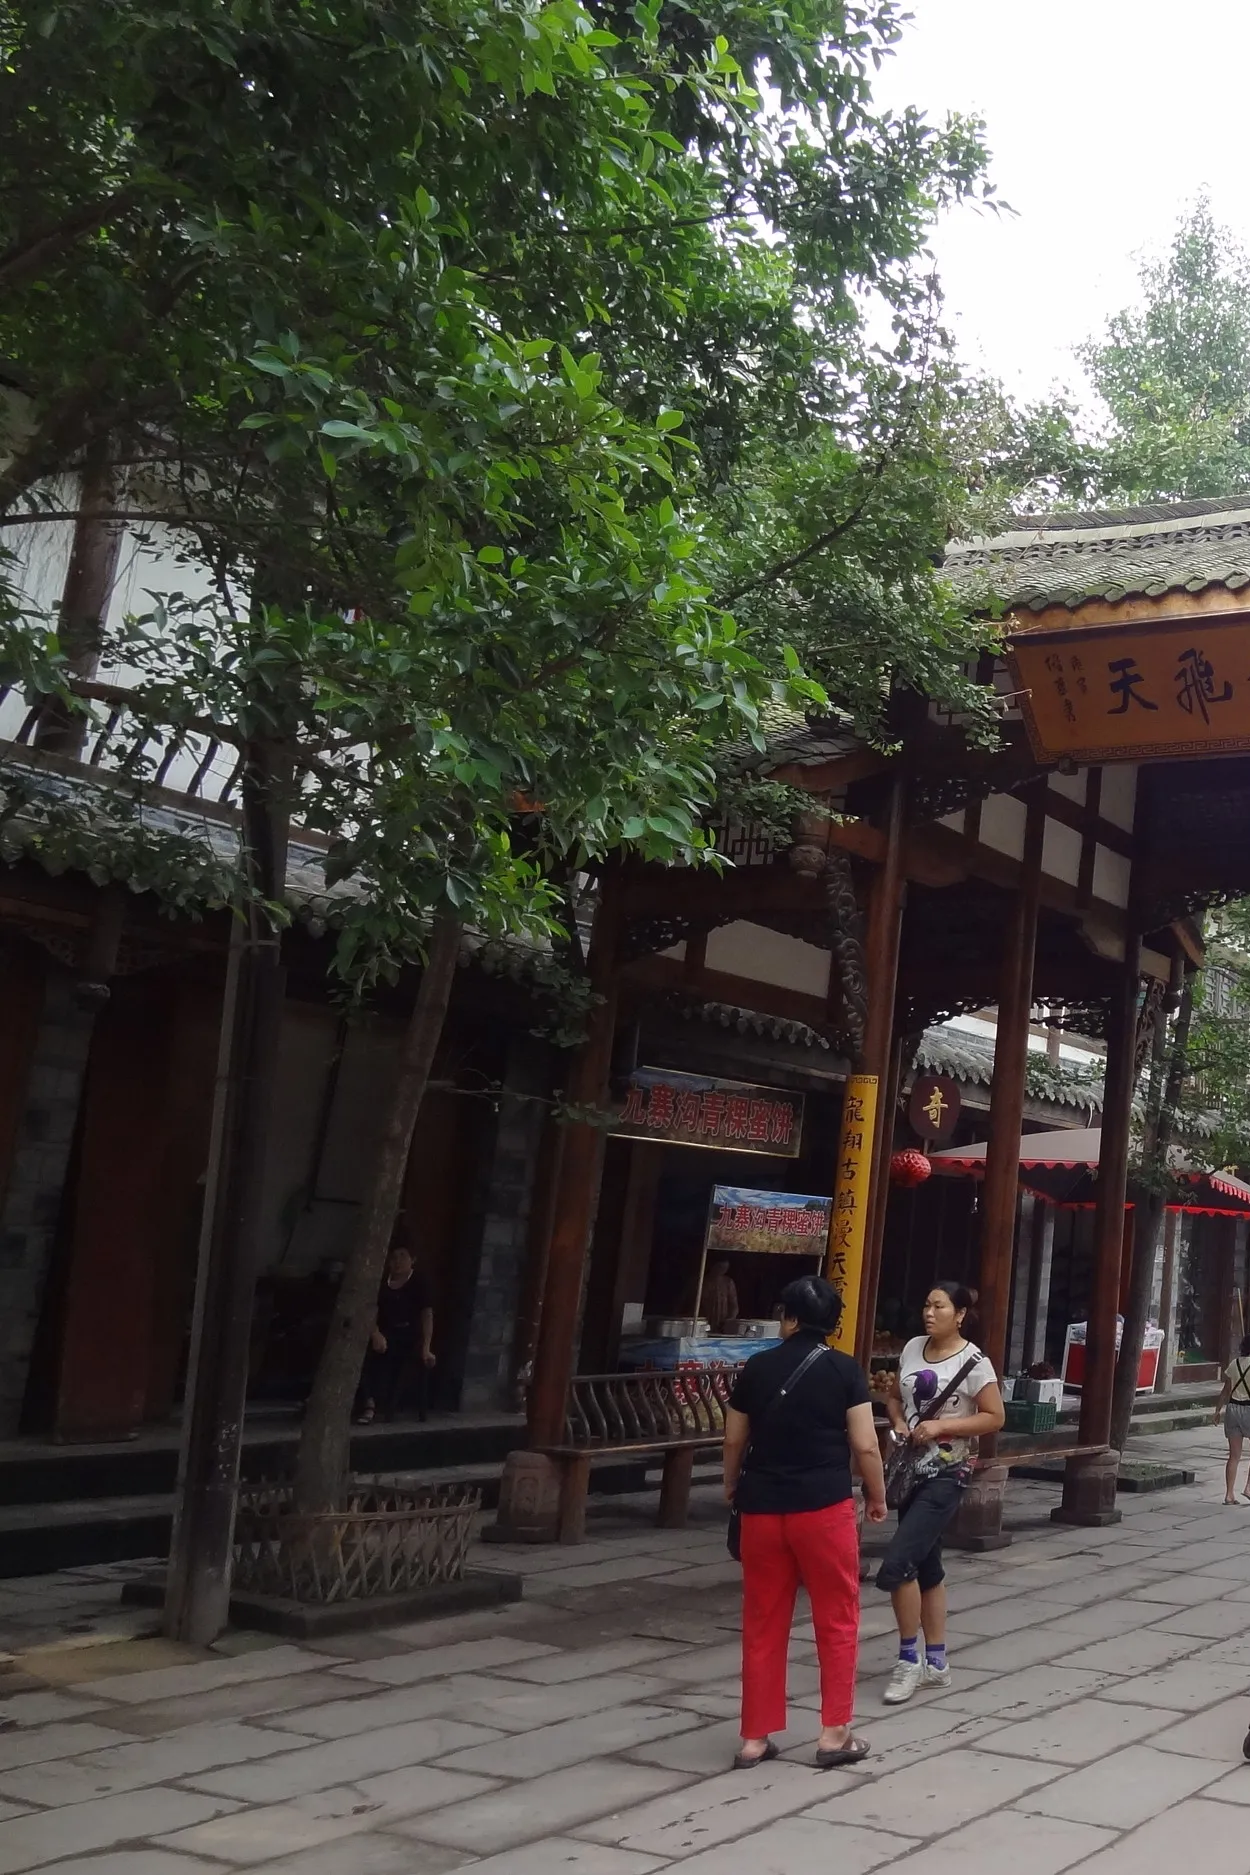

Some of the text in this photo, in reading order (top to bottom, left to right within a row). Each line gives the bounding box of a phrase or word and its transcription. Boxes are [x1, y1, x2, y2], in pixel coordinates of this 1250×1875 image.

[618, 1080, 794, 1145] 九寨沟青稞蜜饼
[922, 1086, 949, 1129] 奇
[716, 1202, 825, 1237] 九寨沟青稞蜜饼
